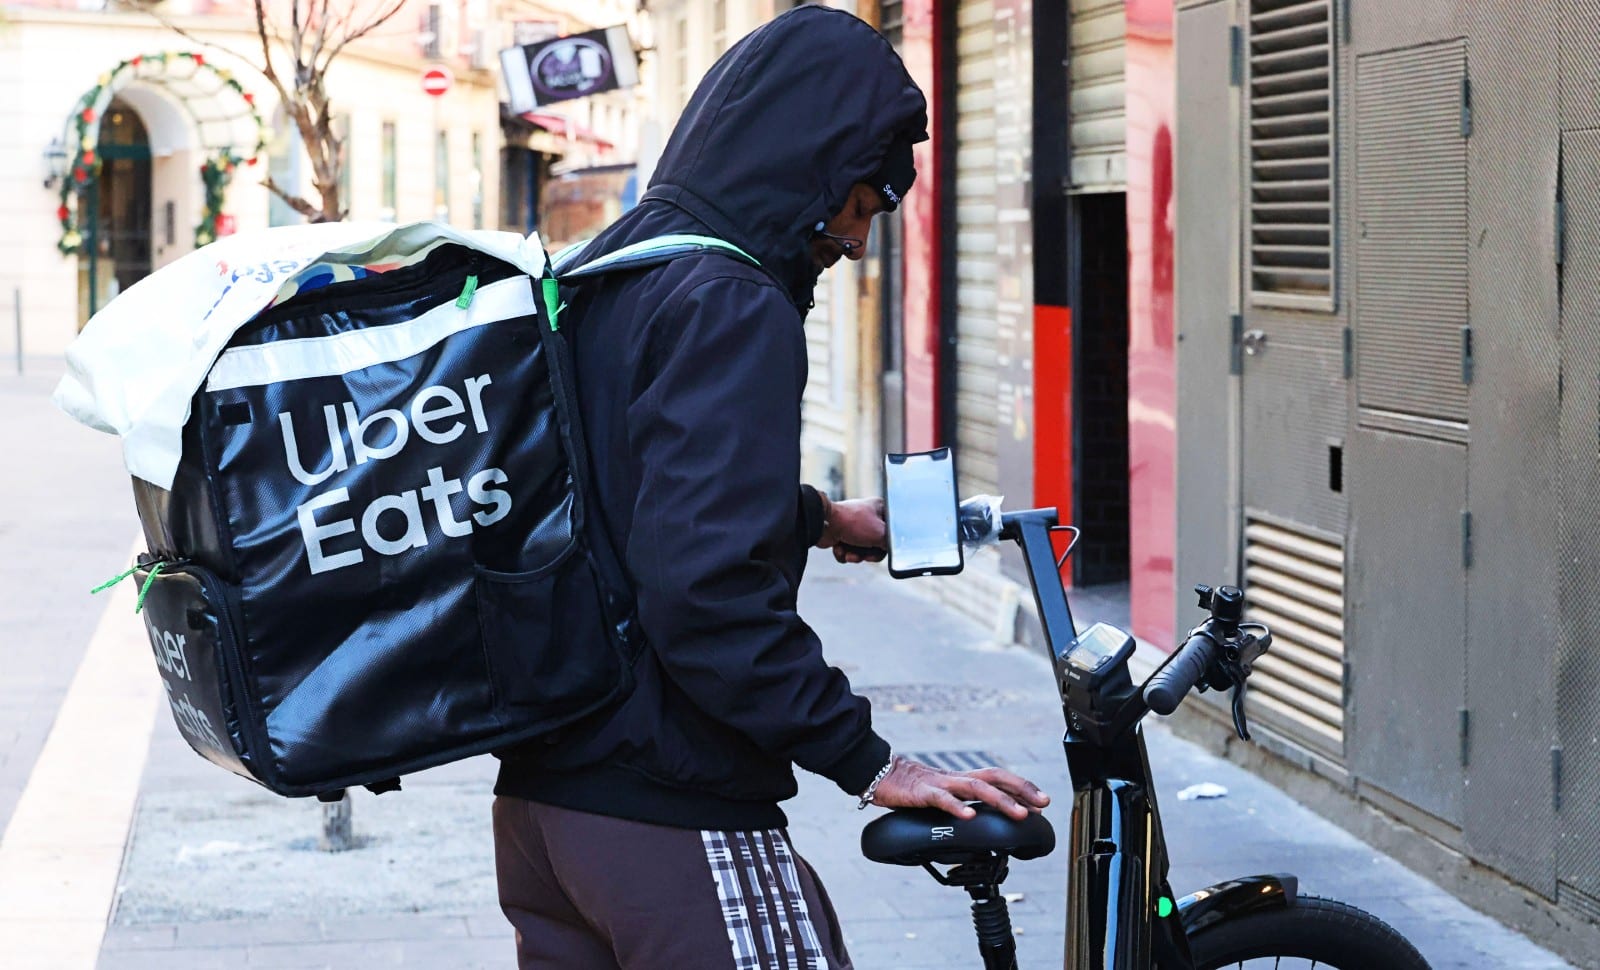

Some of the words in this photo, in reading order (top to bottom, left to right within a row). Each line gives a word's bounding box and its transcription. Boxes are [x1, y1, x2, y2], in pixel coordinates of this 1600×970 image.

[278, 373, 492, 486] Uber
[297, 466, 512, 575] Eats
[143, 608, 192, 681] ber
